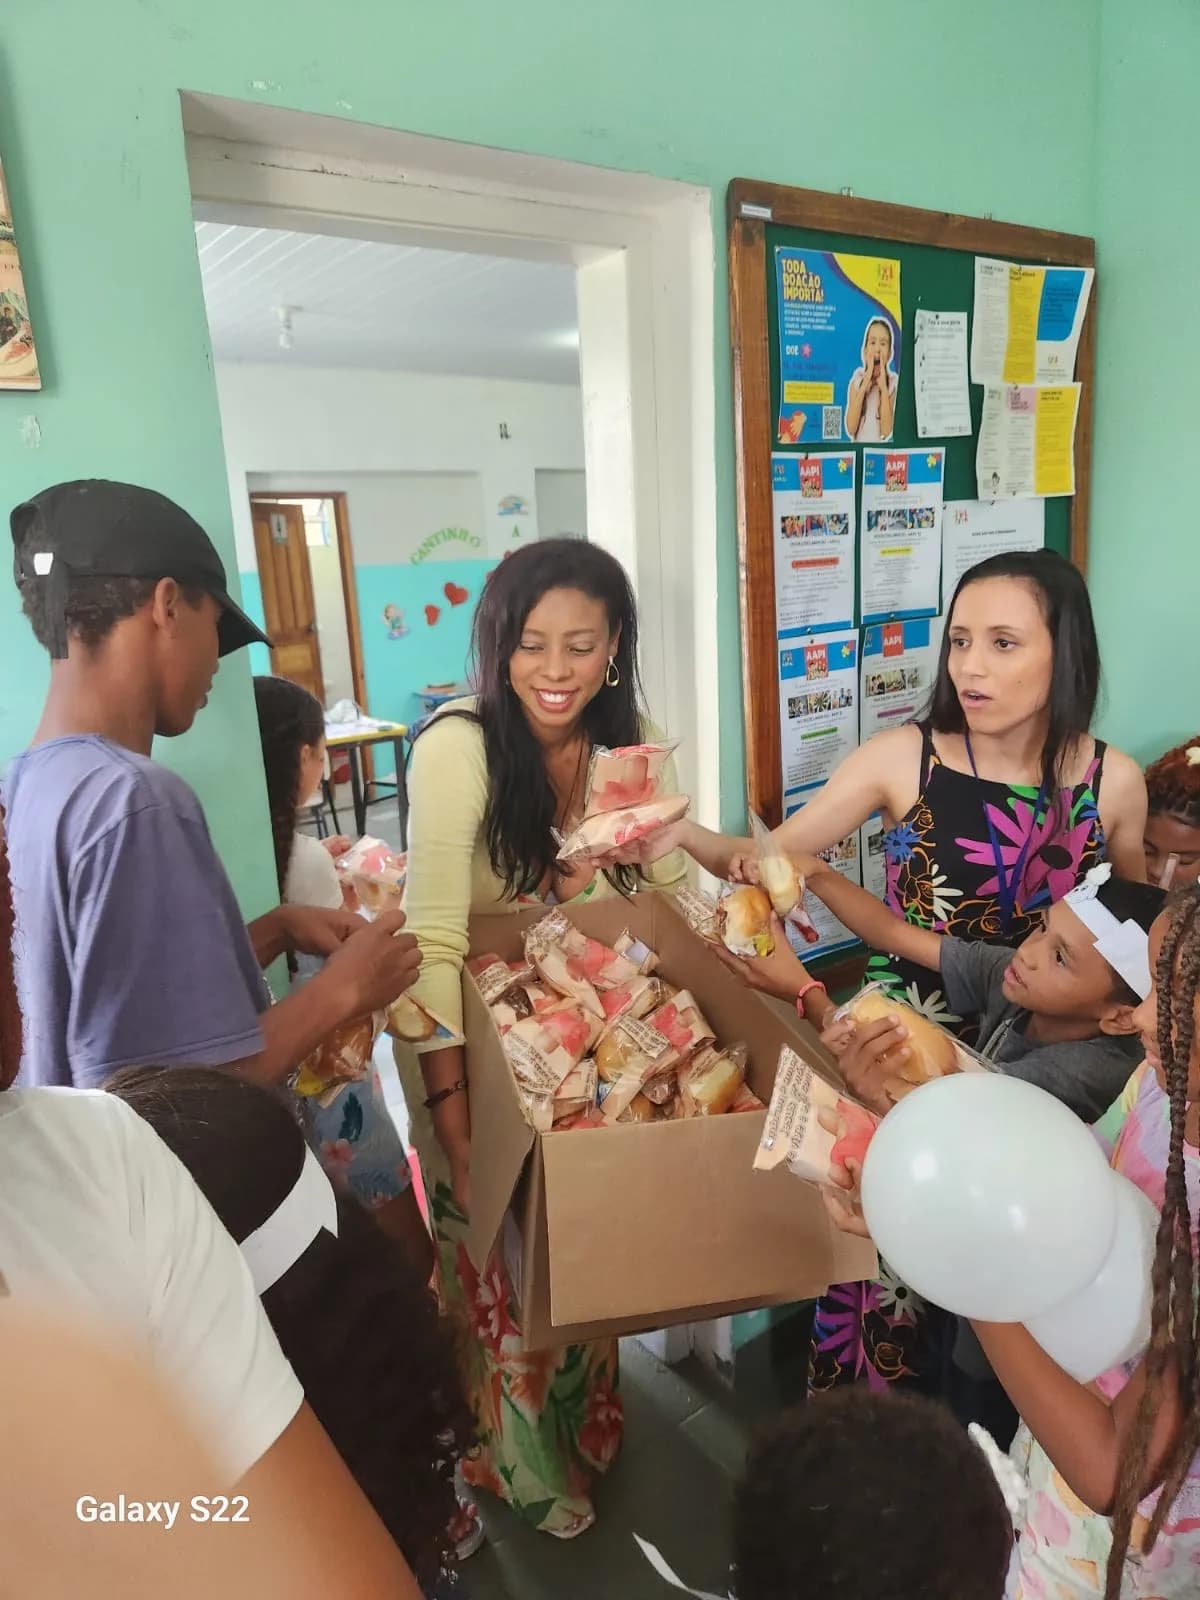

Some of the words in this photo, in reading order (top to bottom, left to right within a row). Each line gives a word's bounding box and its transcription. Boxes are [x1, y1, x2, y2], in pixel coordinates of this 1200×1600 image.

[782, 259, 806, 273] TODA
[783, 271, 821, 289] DOAÇÃO
[784, 288, 824, 303] IMPORTA!
[786, 345, 799, 356] DOE
[800, 465, 820, 477] AAPI
[886, 461, 906, 471] AAPI
[512, 525, 520, 538] A
[410, 527, 481, 566] CANTINHO
[884, 635, 903, 647] AAPI
[807, 648, 826, 661] AAPI
